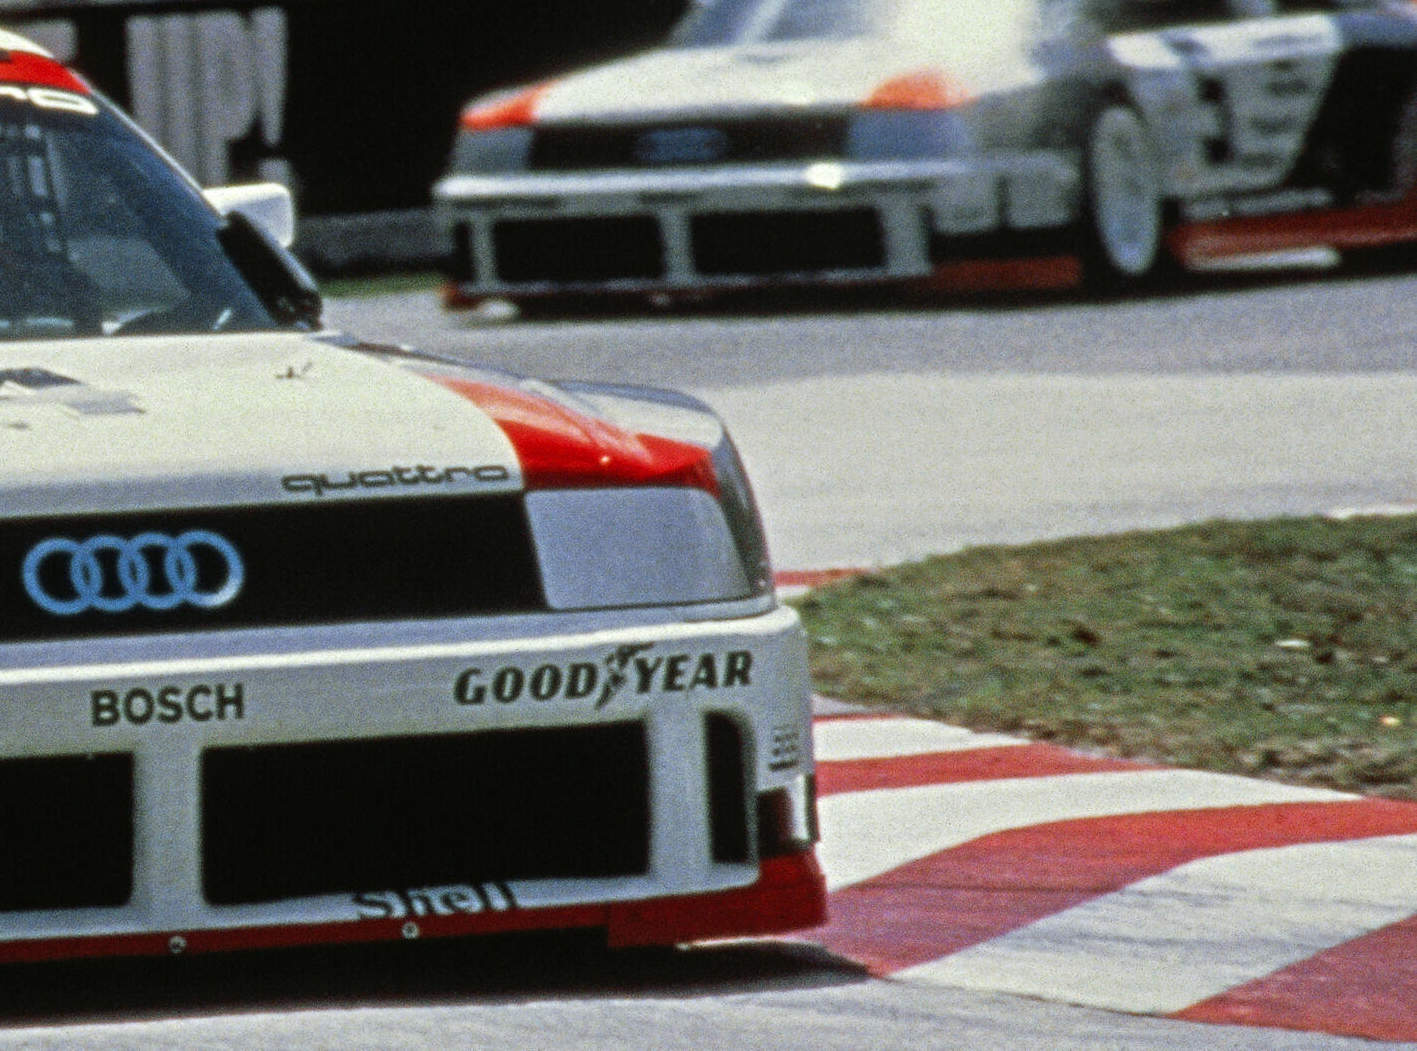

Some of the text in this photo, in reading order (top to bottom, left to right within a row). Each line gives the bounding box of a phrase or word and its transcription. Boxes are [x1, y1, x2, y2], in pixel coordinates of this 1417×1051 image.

[282, 464, 509, 496] quattro
[90, 683, 246, 726] BOSCH
[354, 880, 517, 920] Shell
